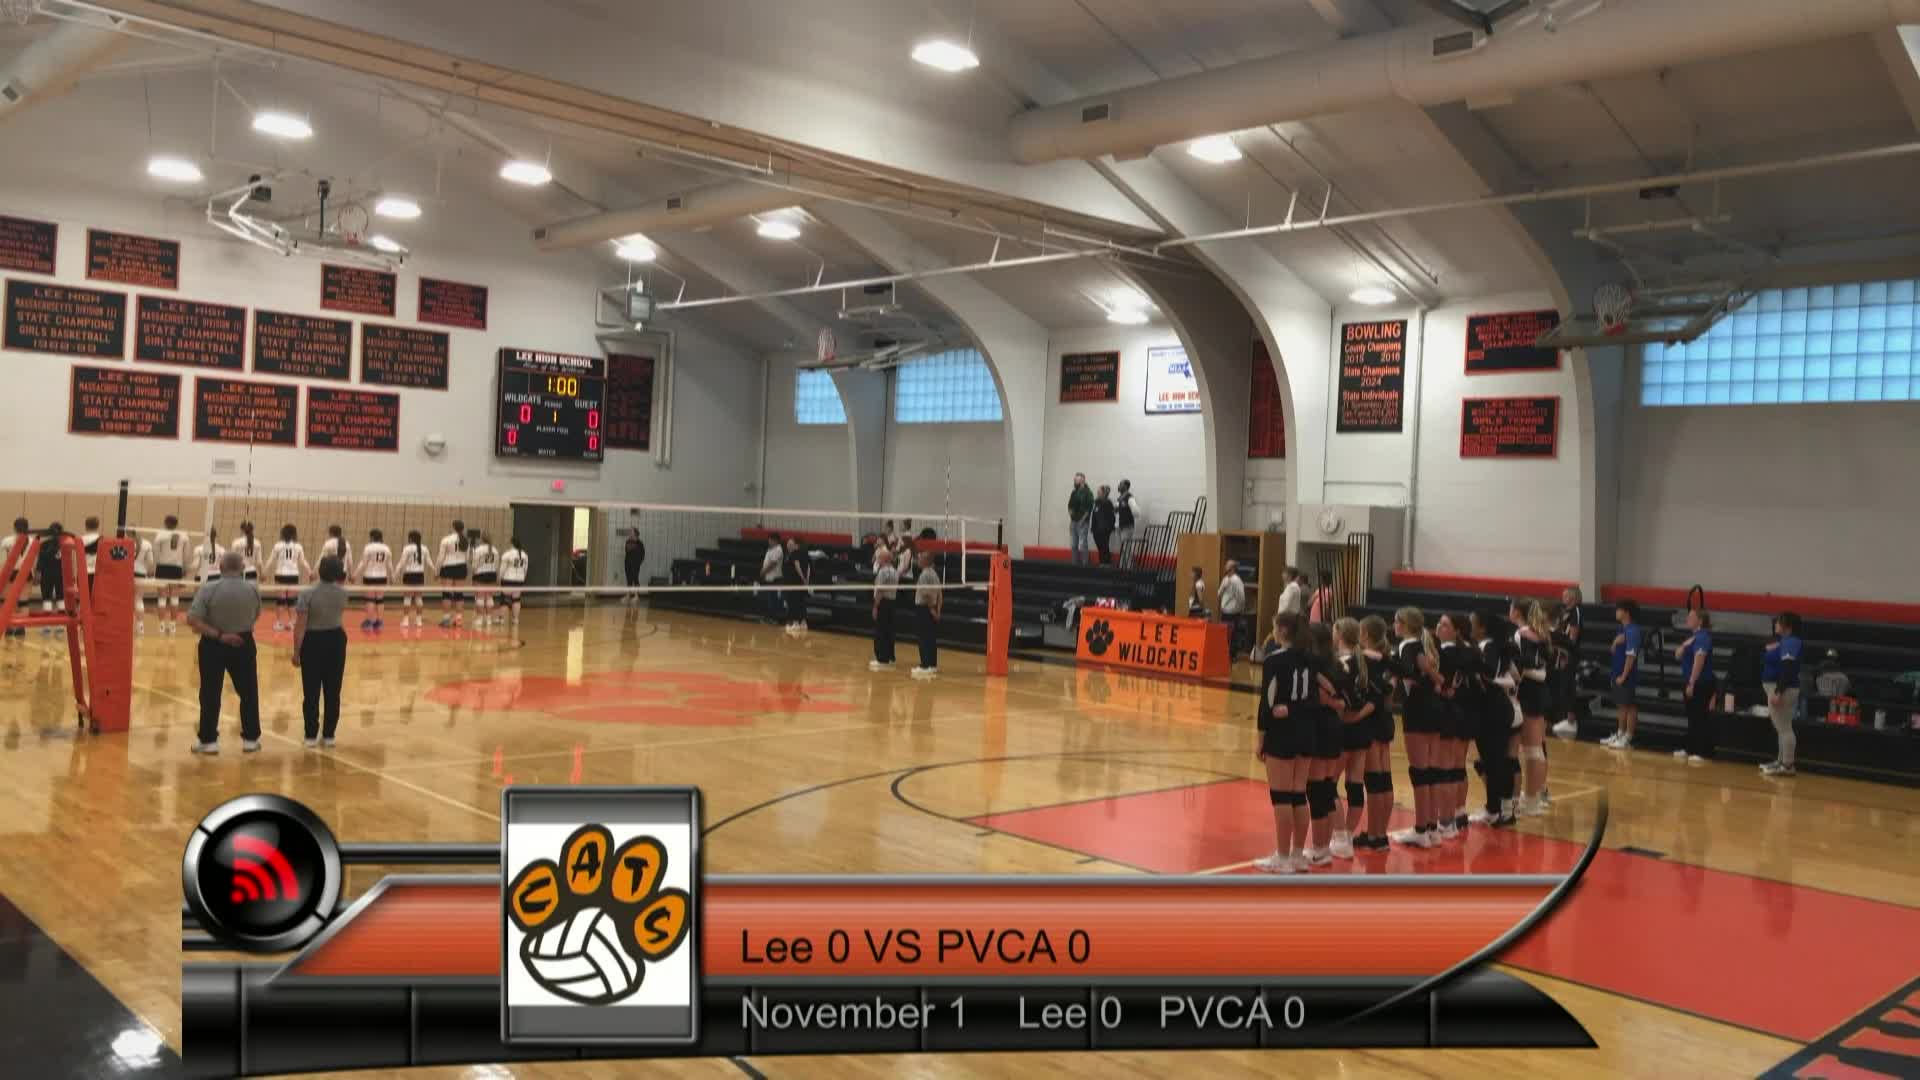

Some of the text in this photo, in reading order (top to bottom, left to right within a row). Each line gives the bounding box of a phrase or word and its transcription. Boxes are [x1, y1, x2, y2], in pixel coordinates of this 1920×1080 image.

[17, 311, 48, 323] STATE
[51, 328, 110, 343] BASKETBALL
[143, 323, 176, 335] STATE
[1346, 323, 1401, 340] BOWLING
[176, 339, 235, 353] BASKETBALL
[261, 336, 288, 348] STATE
[1367, 341, 1401, 352] Champions
[291, 352, 341, 366] BASKETBALL
[367, 349, 391, 360] STATE
[516, 351, 593, 368] LEE HIGH SCHOOL
[394, 362, 440, 376] BASKETBALL
[1344, 365, 1400, 377] State Champions
[548, 376, 577, 396] 1:00
[1361, 376, 1382, 387] 2024
[82, 395, 113, 406] STATE
[504, 393, 541, 405] WILDCATS
[1343, 391, 1360, 400] State
[207, 404, 233, 416] STATE
[574, 400, 598, 410] GUEST
[112, 409, 165, 423] BASKETBALL
[315, 413, 340, 423] STATE
[520, 403, 532, 424] 0
[588, 410, 599, 429] 0
[235, 418, 284, 430] BASKETBALL
[340, 426, 392, 437] BASKETBALL
[507, 429, 517, 446] 0
[588, 435, 597, 450] 0
[1140, 621, 1179, 645] LEE
[1118, 641, 1199, 671] WILDCATS
[1290, 667, 1309, 701] 11
